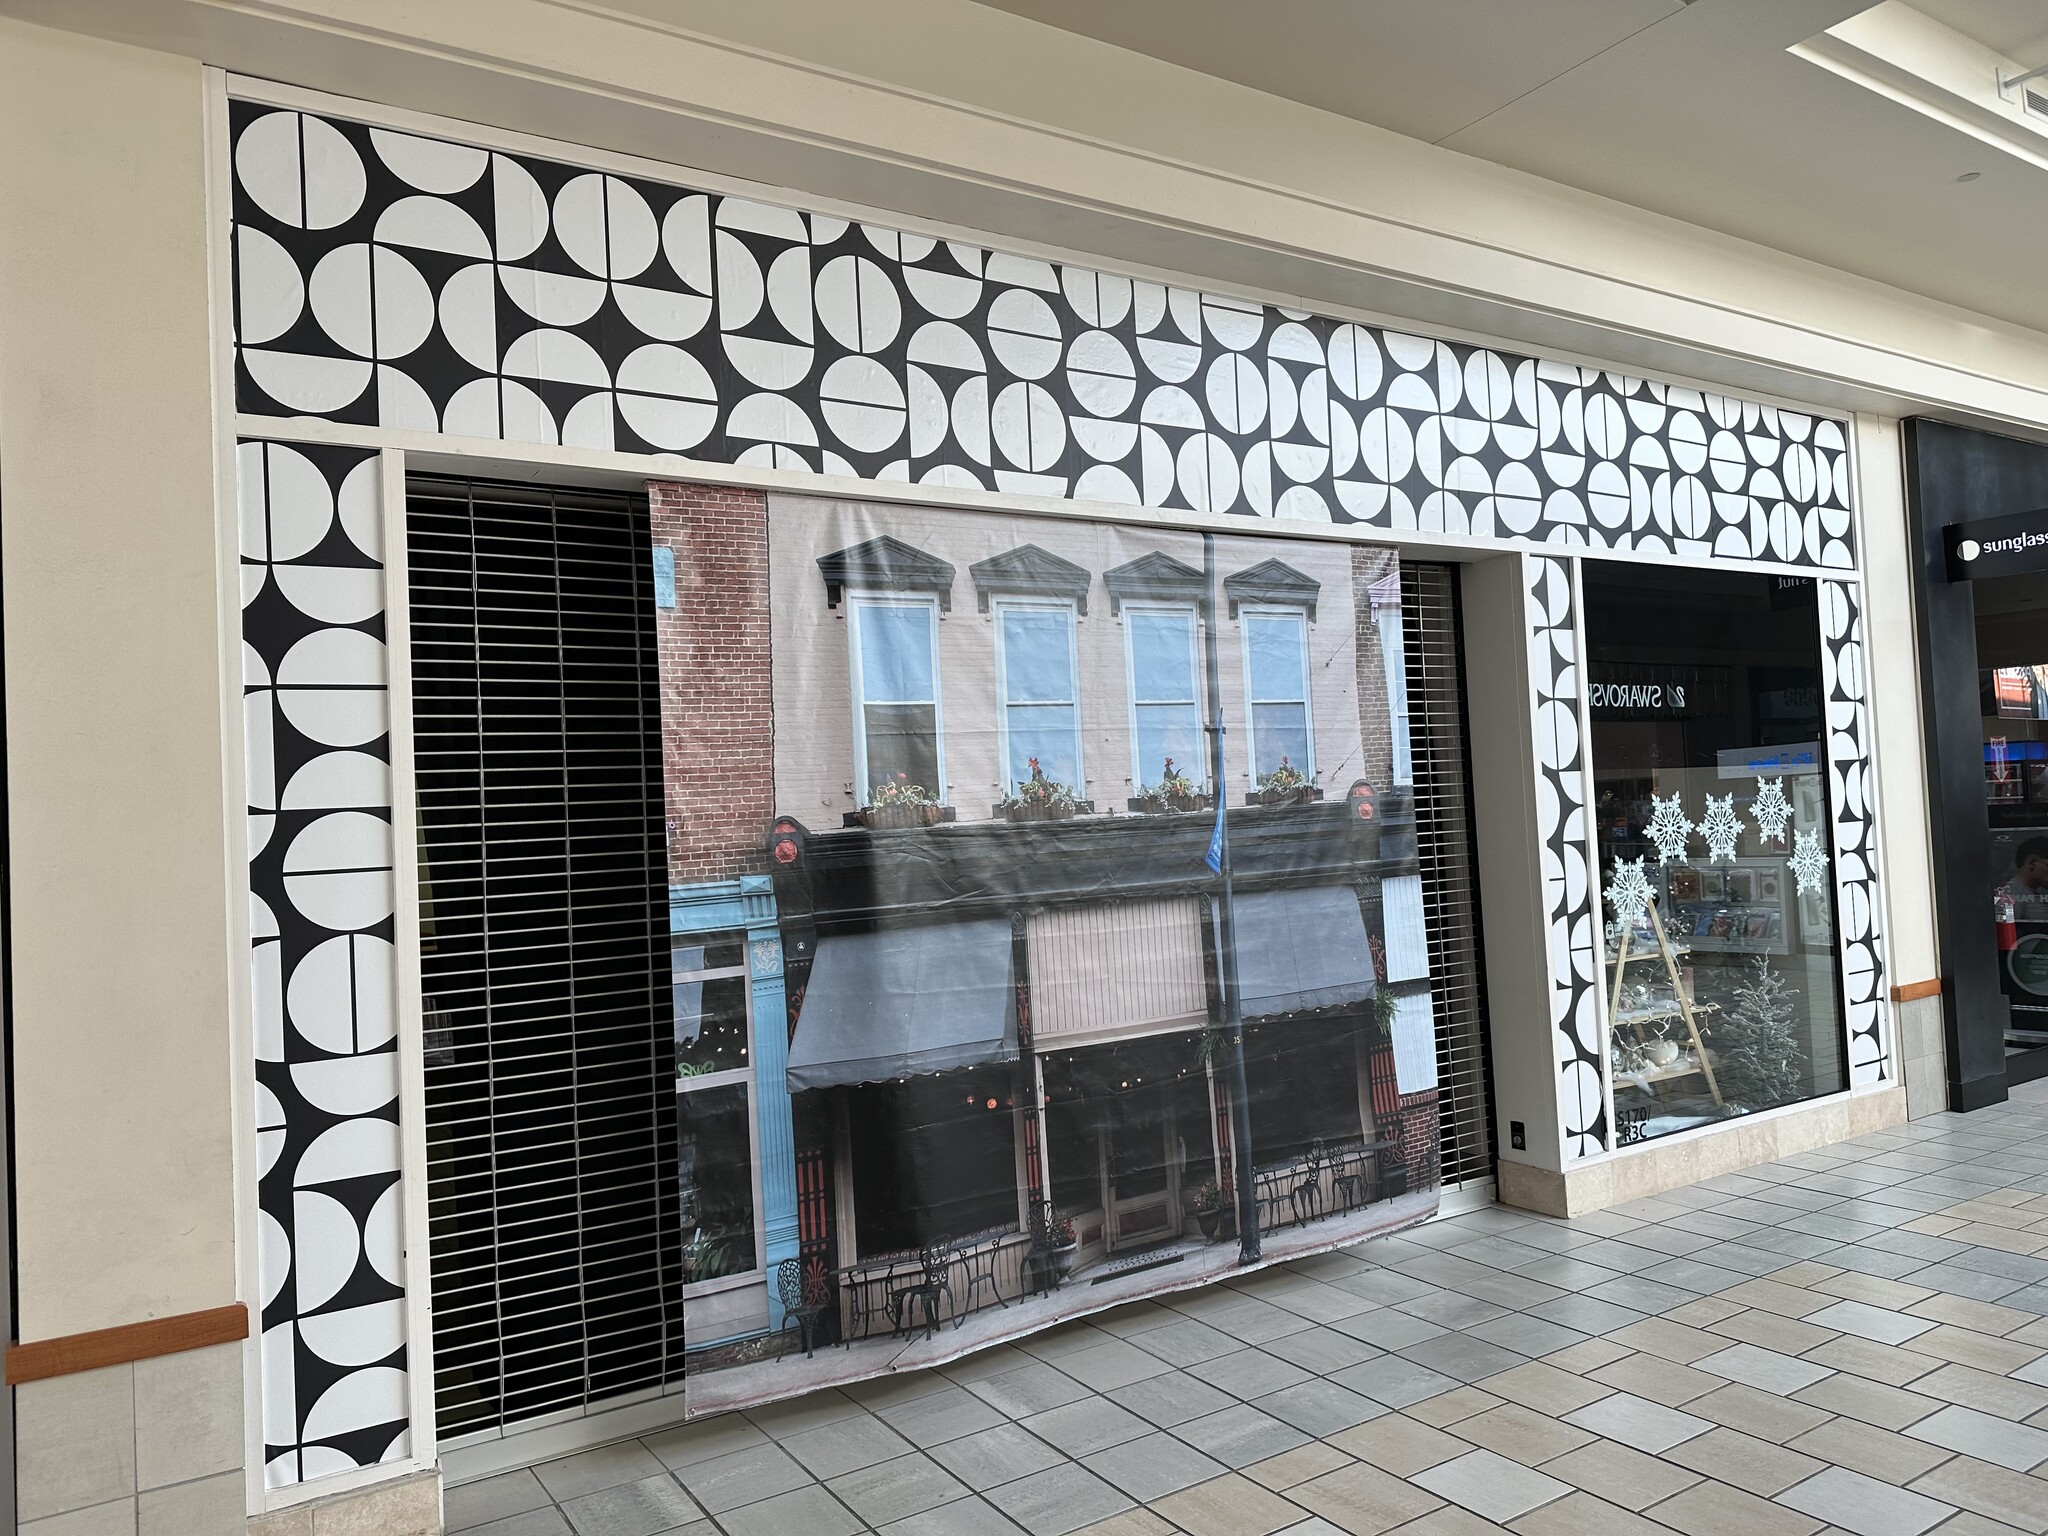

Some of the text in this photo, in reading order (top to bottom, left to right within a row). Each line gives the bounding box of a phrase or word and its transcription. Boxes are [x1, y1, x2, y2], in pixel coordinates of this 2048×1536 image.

[1992, 739, 2005, 747] FIRE
[1616, 1105, 1652, 1126] S170/
[1624, 1122, 1648, 1142] R3C
